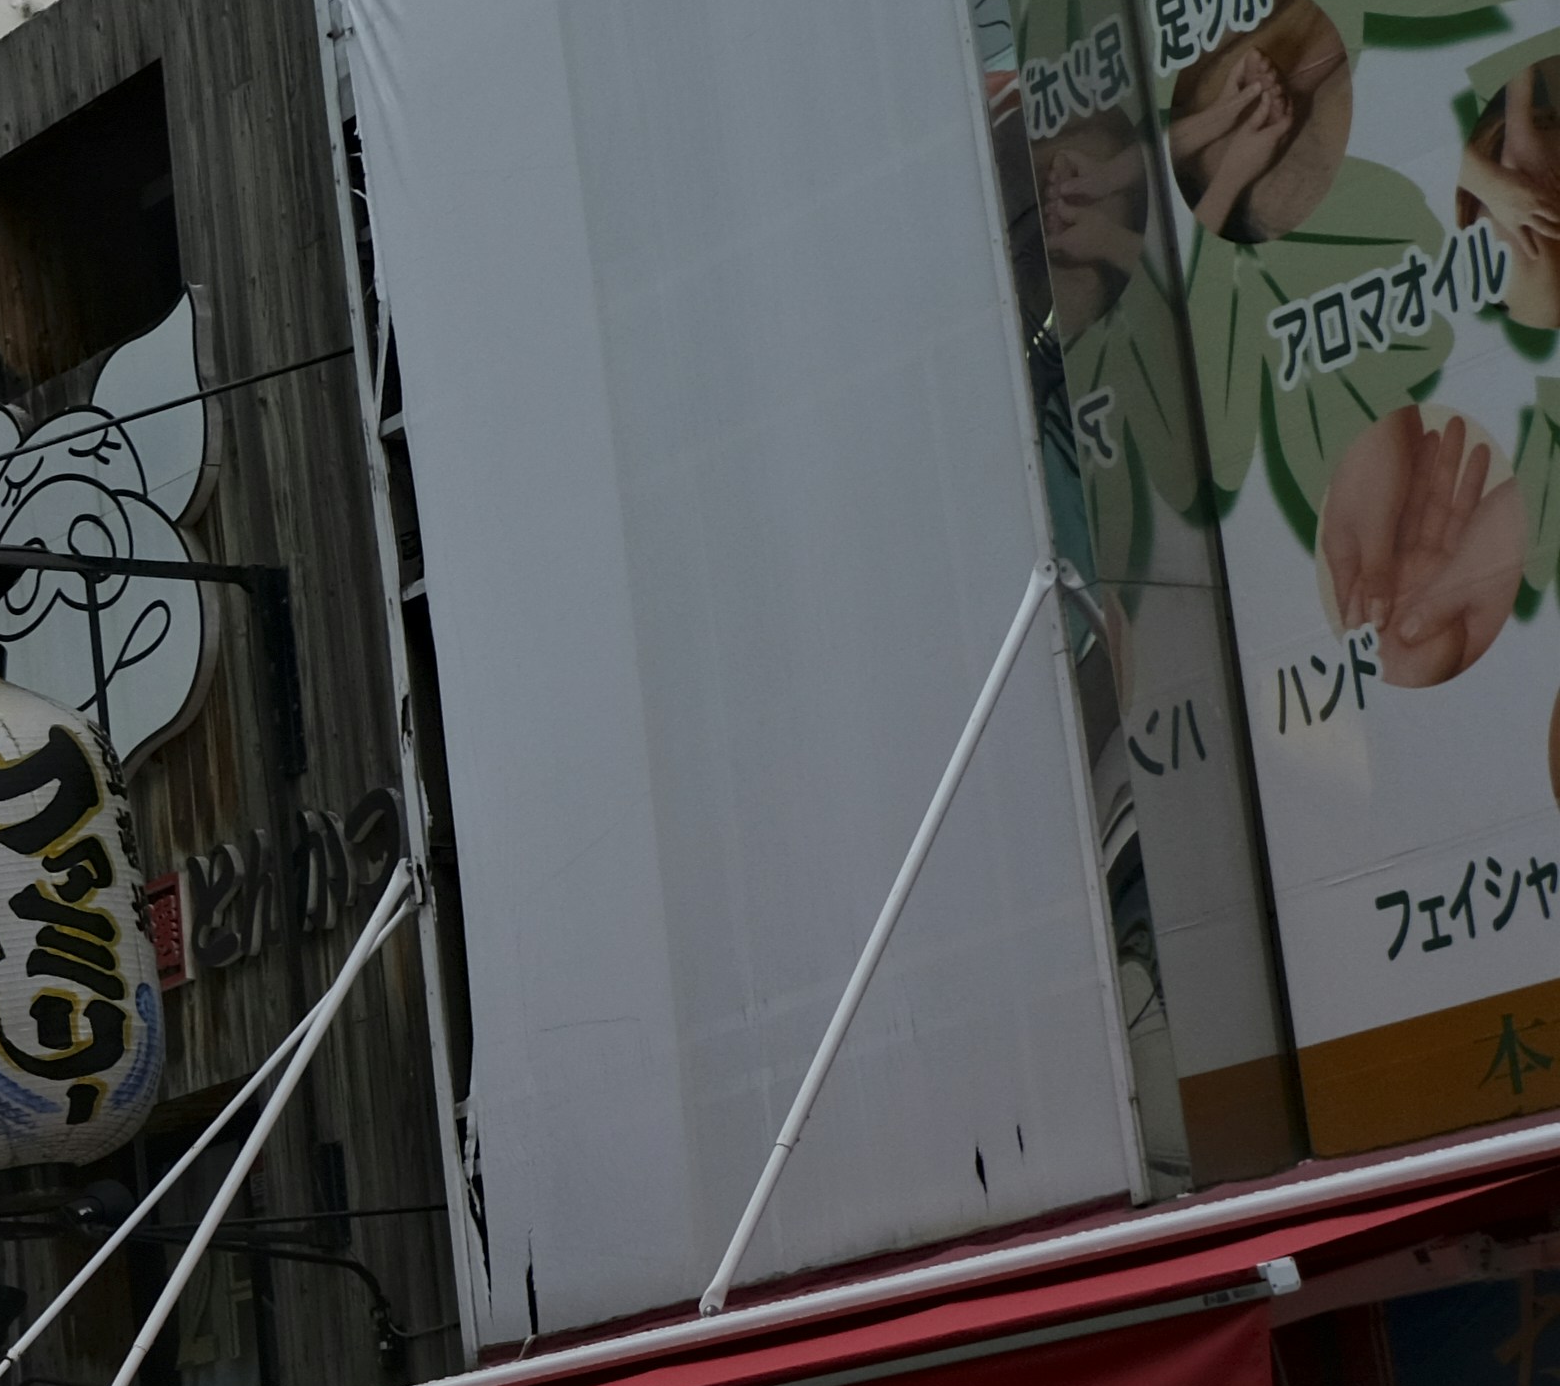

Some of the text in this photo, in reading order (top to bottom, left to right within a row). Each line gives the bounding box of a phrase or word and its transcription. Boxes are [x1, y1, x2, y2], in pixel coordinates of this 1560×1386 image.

[1272, 227, 1505, 385] アロマオイル
[1277, 629, 1378, 734] ハンド
